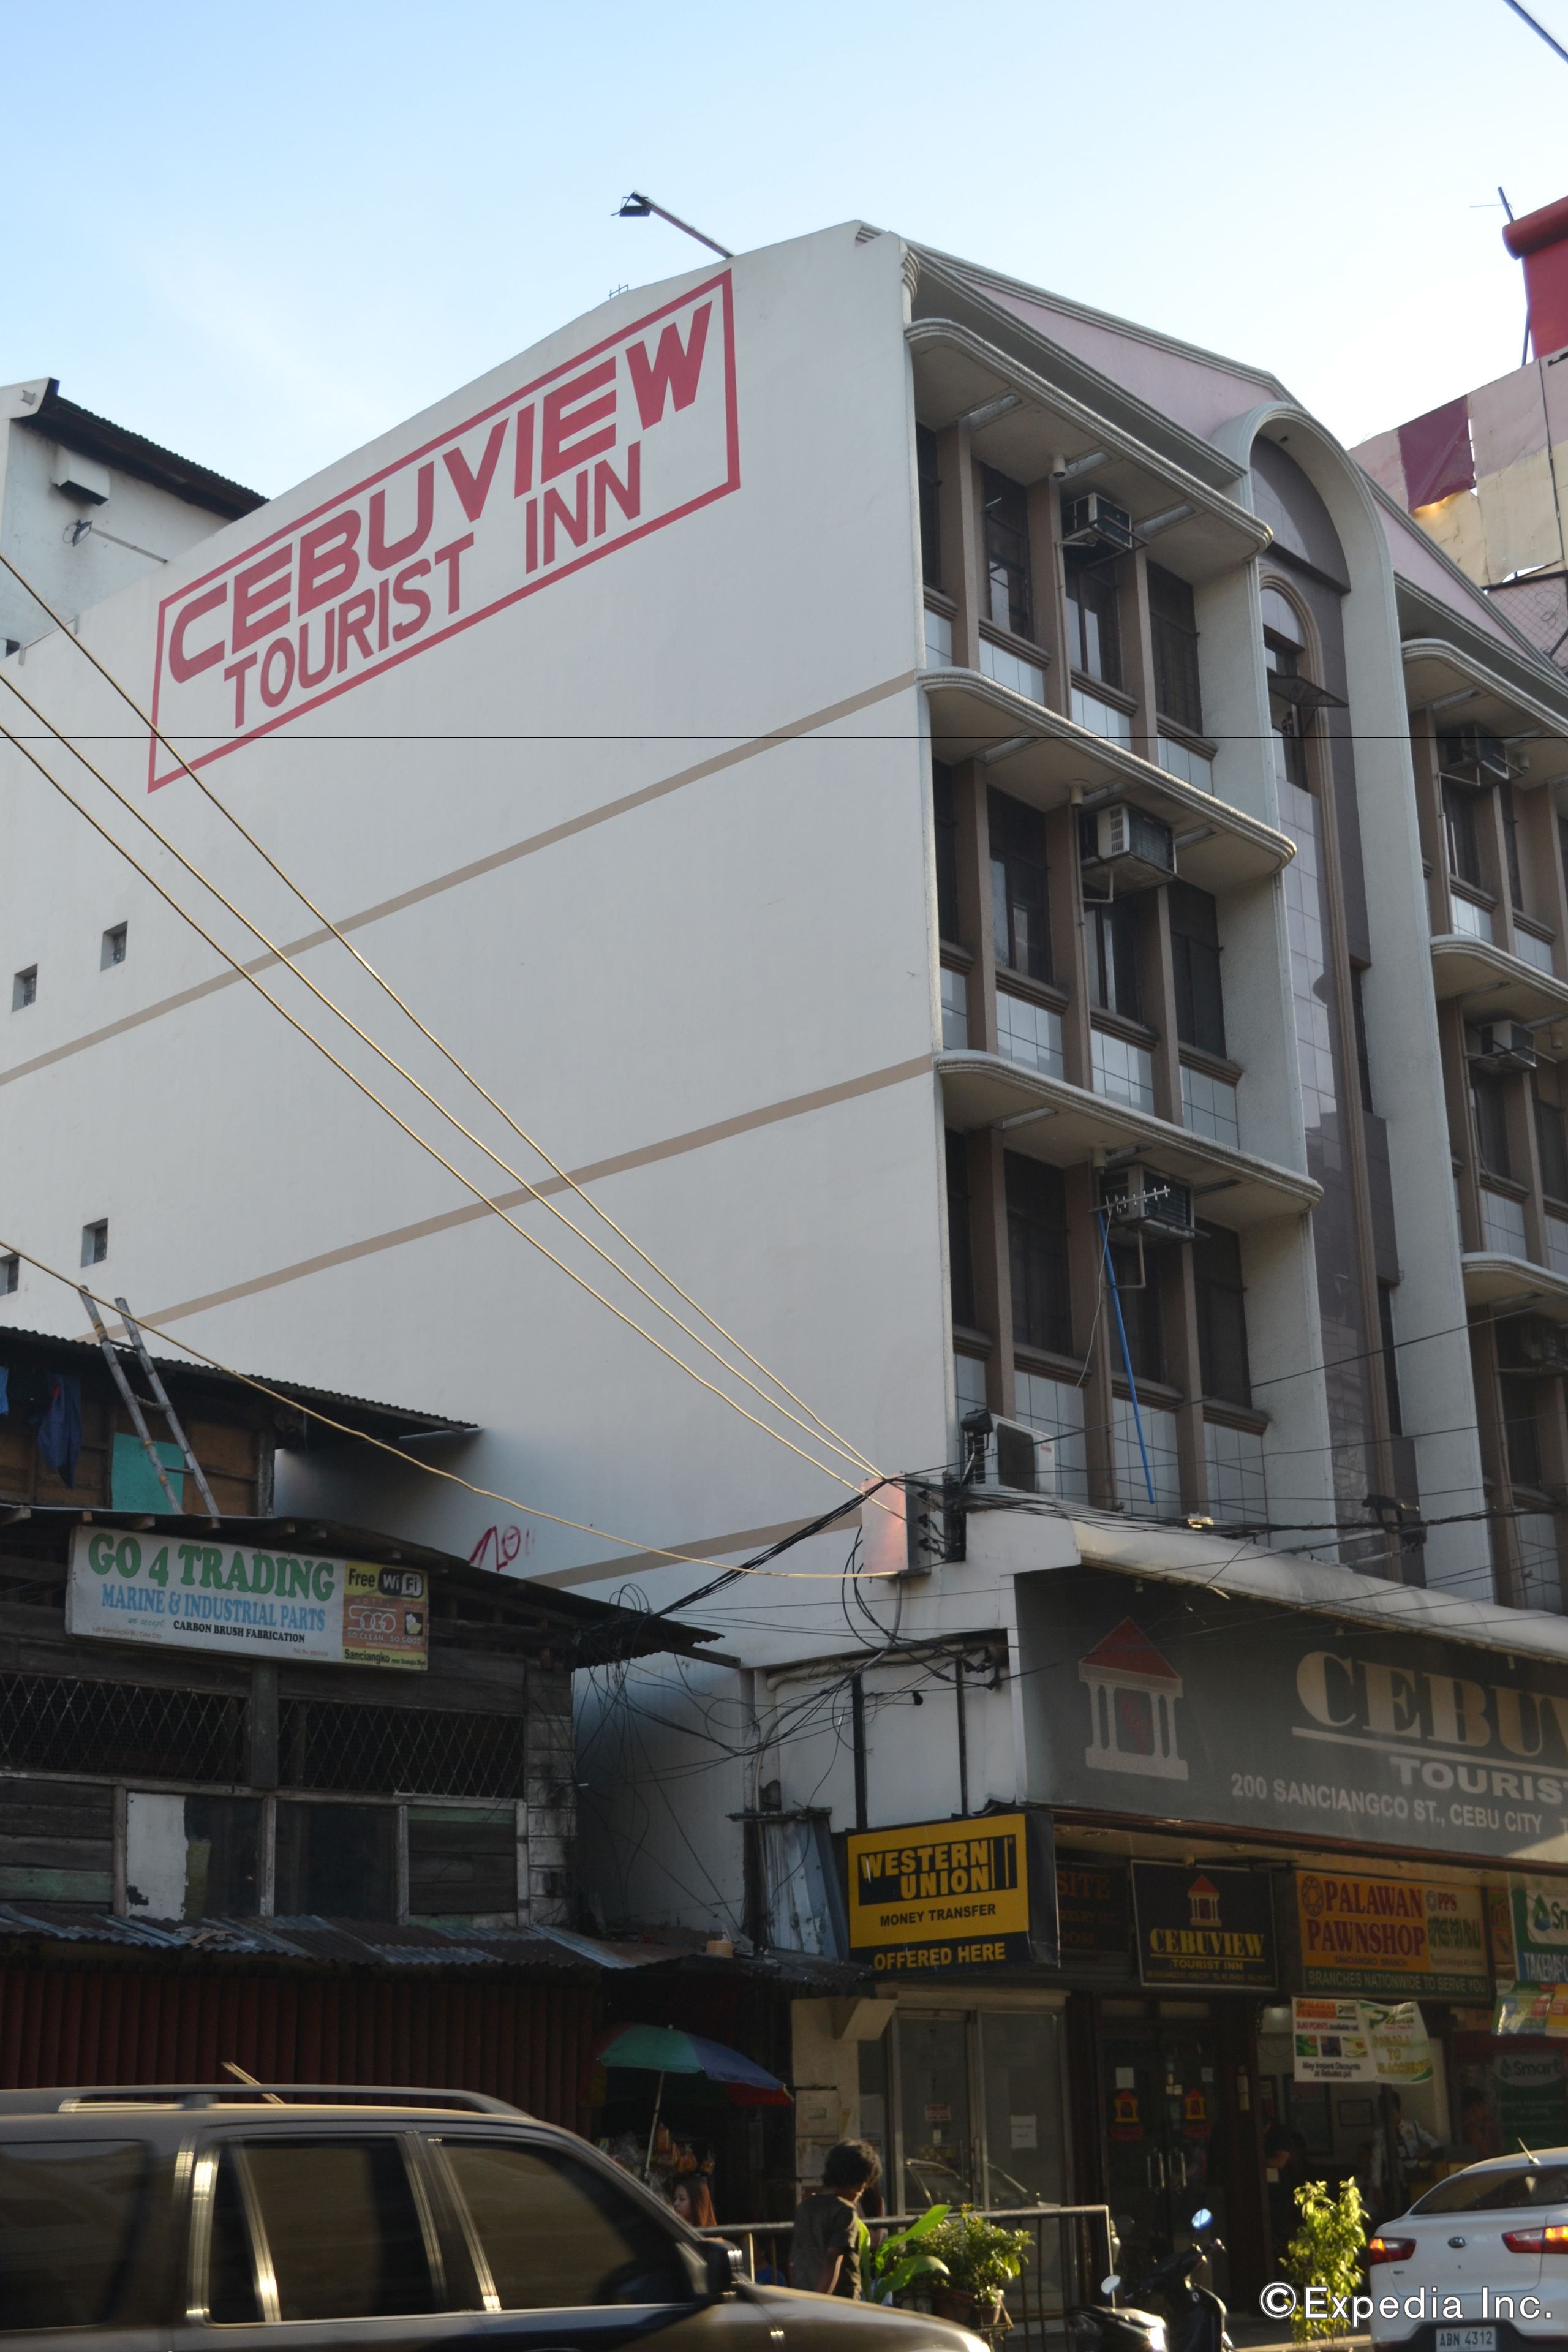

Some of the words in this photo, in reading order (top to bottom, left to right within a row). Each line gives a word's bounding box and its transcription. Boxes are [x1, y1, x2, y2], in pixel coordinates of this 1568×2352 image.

[169, 300, 713, 684] CEBUVIEW
[224, 532, 474, 729] TOURIST
[525, 441, 641, 575] INN
[88, 1533, 141, 1578] GO
[149, 1546, 168, 1587] 4
[178, 1544, 335, 1601] TRADING
[348, 1568, 375, 1588] Free
[101, 1583, 165, 1613] MARINE
[168, 1591, 181, 1615] &
[184, 1593, 277, 1627] INDUSTRIAL
[280, 1607, 326, 1632] PARTS
[173, 1620, 212, 1634] CARBON
[214, 1625, 244, 1637] BRUSH
[246, 1629, 305, 1643] FABRICATION
[344, 1649, 390, 1665] Sanciangko
[1389, 1757, 1568, 1804] TOURIS
[1231, 1773, 1267, 1800] 200
[1273, 1779, 1408, 1819] SANCIANGCO
[1413, 1800, 1446, 1827] ST.,
[1450, 1804, 1499, 1830] CEBU
[1504, 1812, 1543, 1834] CITY
[861, 1840, 989, 1879] WESTERN
[900, 1865, 990, 1900] UNION
[1324, 1880, 1423, 1918] PALAWAN
[1438, 1893, 1457, 1912] PPS
[880, 1911, 924, 1927] MONEY
[929, 1904, 996, 1921] TRANSFER
[1150, 1928, 1264, 1957] CEBUVIEW
[1307, 1918, 1425, 1956] PAWNSHOP
[873, 1947, 952, 1972] OFFERED
[957, 1942, 1006, 1964] HERE
[1172, 1959, 1221, 1970] TOURIST
[1224, 1961, 1244, 1971] INN
[1308, 1970, 1362, 1988] BRANCHES
[1364, 1973, 1421, 1990] NATIONWIDE
[1423, 1976, 1436, 1989] TO
[1437, 1977, 1466, 1992] SERVE
[1513, 2058, 1561, 2076] Smart
[1439, 2332, 1460, 2346] ABN
[1464, 2331, 1493, 2345] 4312
